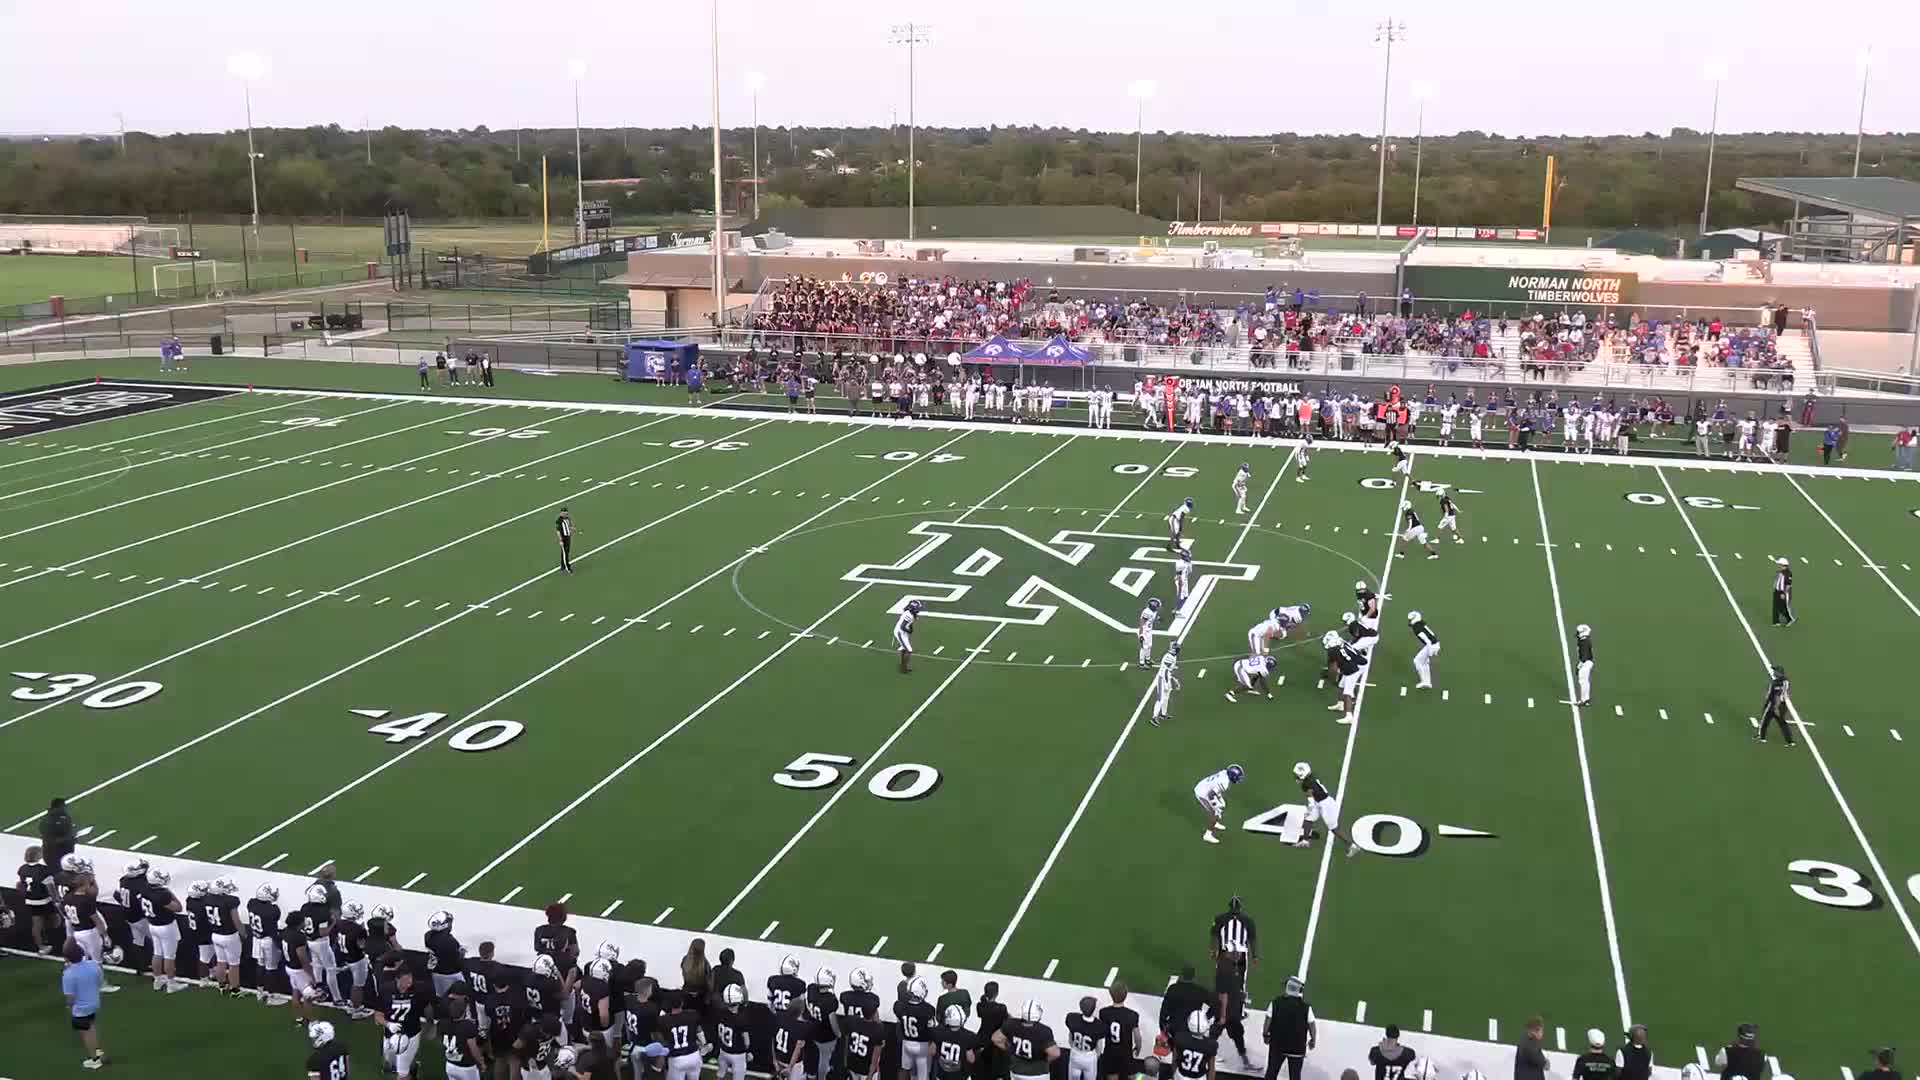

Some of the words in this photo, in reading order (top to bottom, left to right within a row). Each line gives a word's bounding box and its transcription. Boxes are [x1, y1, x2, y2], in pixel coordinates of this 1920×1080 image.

[1168, 221, 1252, 236] Timberwolves
[1508, 275, 1568, 290] NORMAN
[1571, 278, 1621, 291] NORTH
[1527, 289, 1619, 303] TIMBERWOLVES
[772, 751, 942, 801] 50
[470, 970, 489, 994] 70
[389, 1003, 412, 1022] 77
[671, 1025, 690, 1050] 17
[901, 1014, 920, 1039] 16
[1109, 1021, 1122, 1044] 9
[775, 1027, 790, 1054] 41
[850, 1030, 870, 1058] 35
[1011, 1036, 1034, 1061] 79
[939, 1040, 962, 1066] 50
[1182, 1049, 1205, 1073] 37
